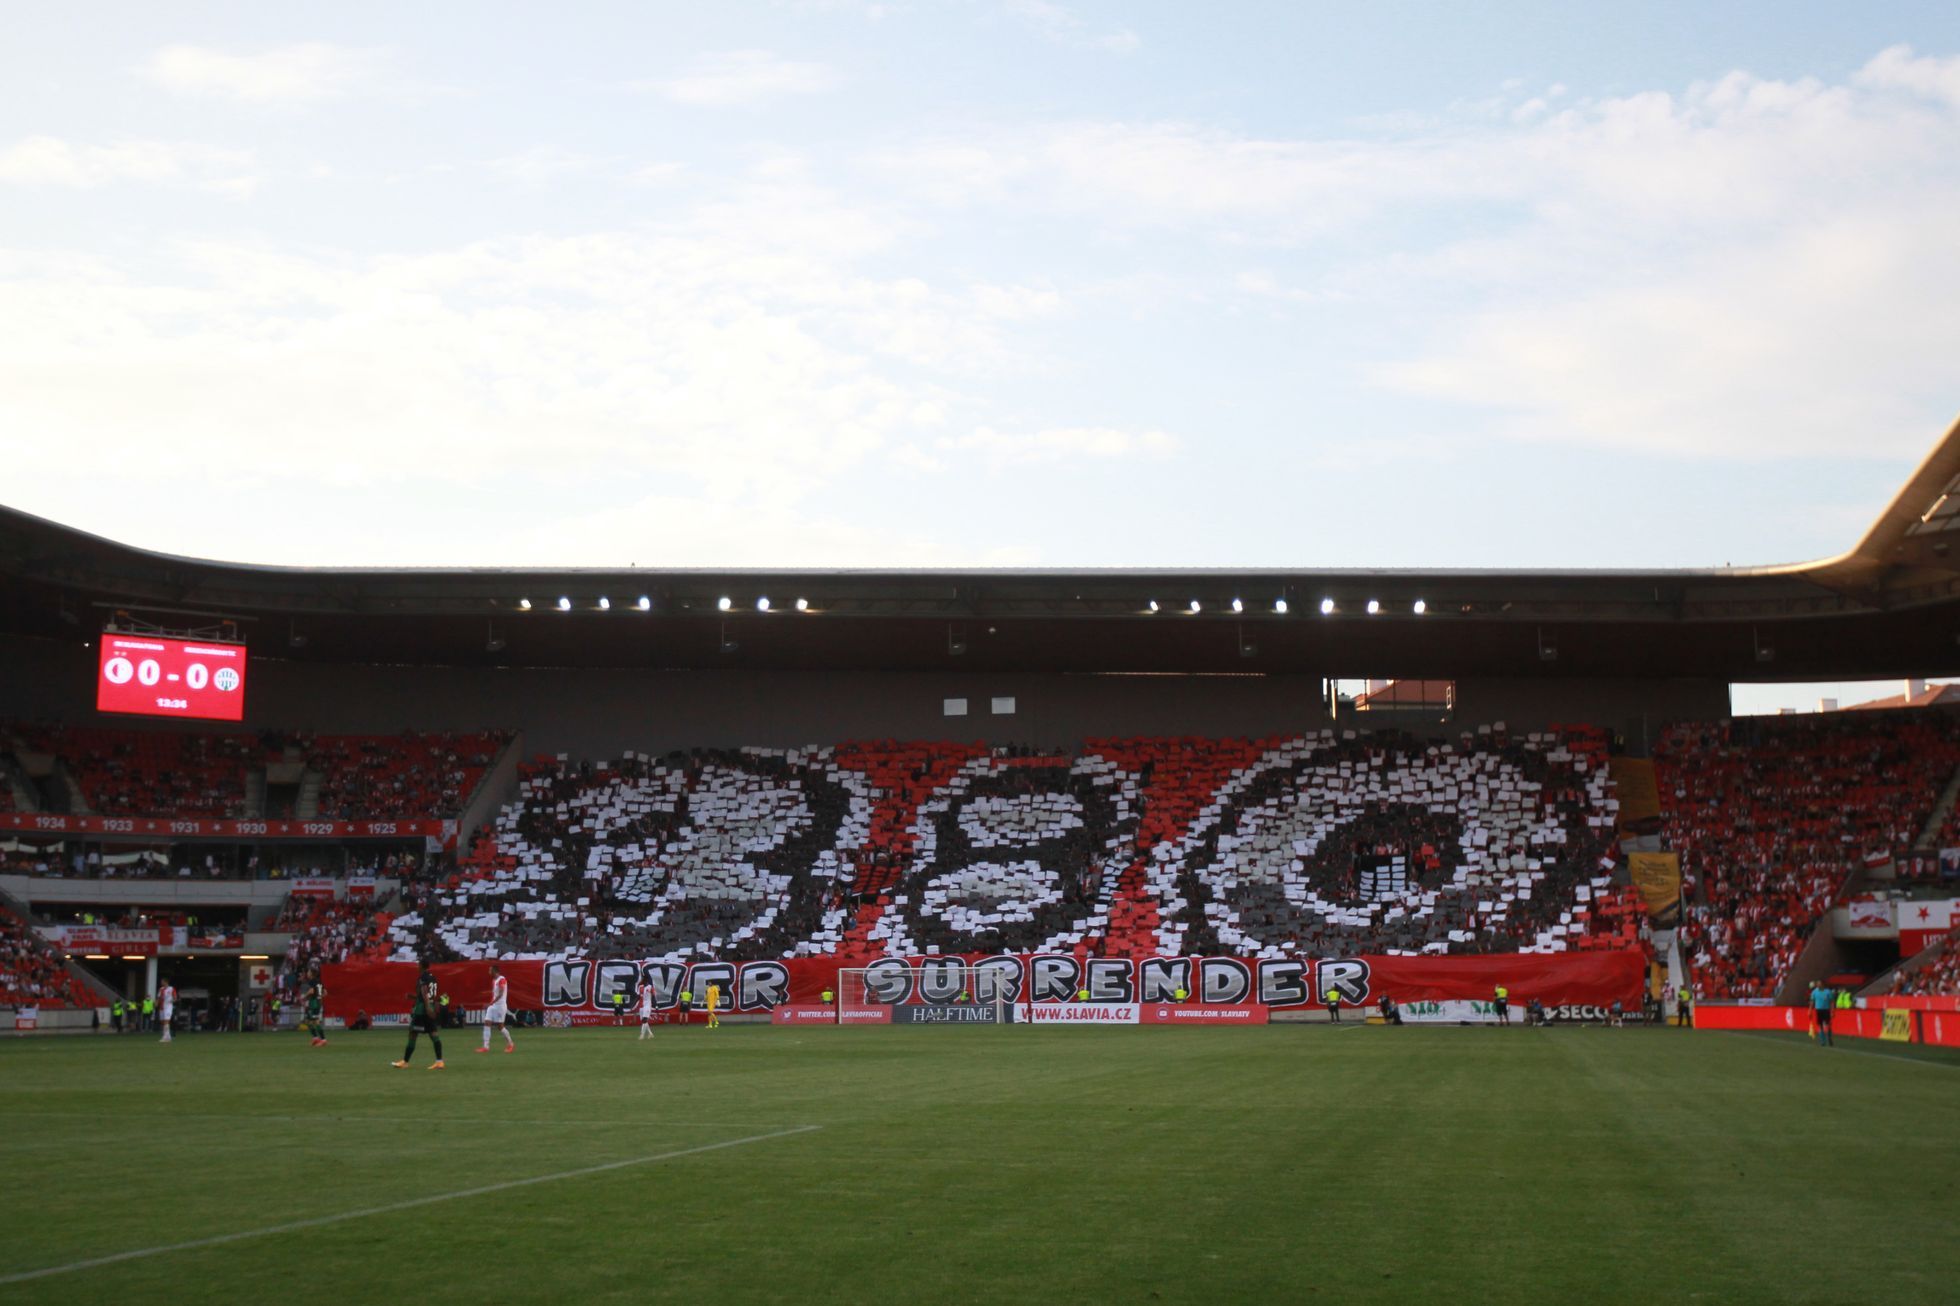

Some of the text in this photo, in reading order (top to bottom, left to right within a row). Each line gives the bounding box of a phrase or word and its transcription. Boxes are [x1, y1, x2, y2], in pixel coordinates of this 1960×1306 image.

[138, 659, 160, 686] 0
[186, 663, 208, 689] 0
[35, 816, 397, 834] 1934 1933 1931 1930 1929 1925
[543, 957, 1370, 1012] NEVER SURRENDER
[912, 1007, 993, 1021] HALFTIME
[1021, 1008, 1132, 1020] WWW.SLAVIA.CZ
